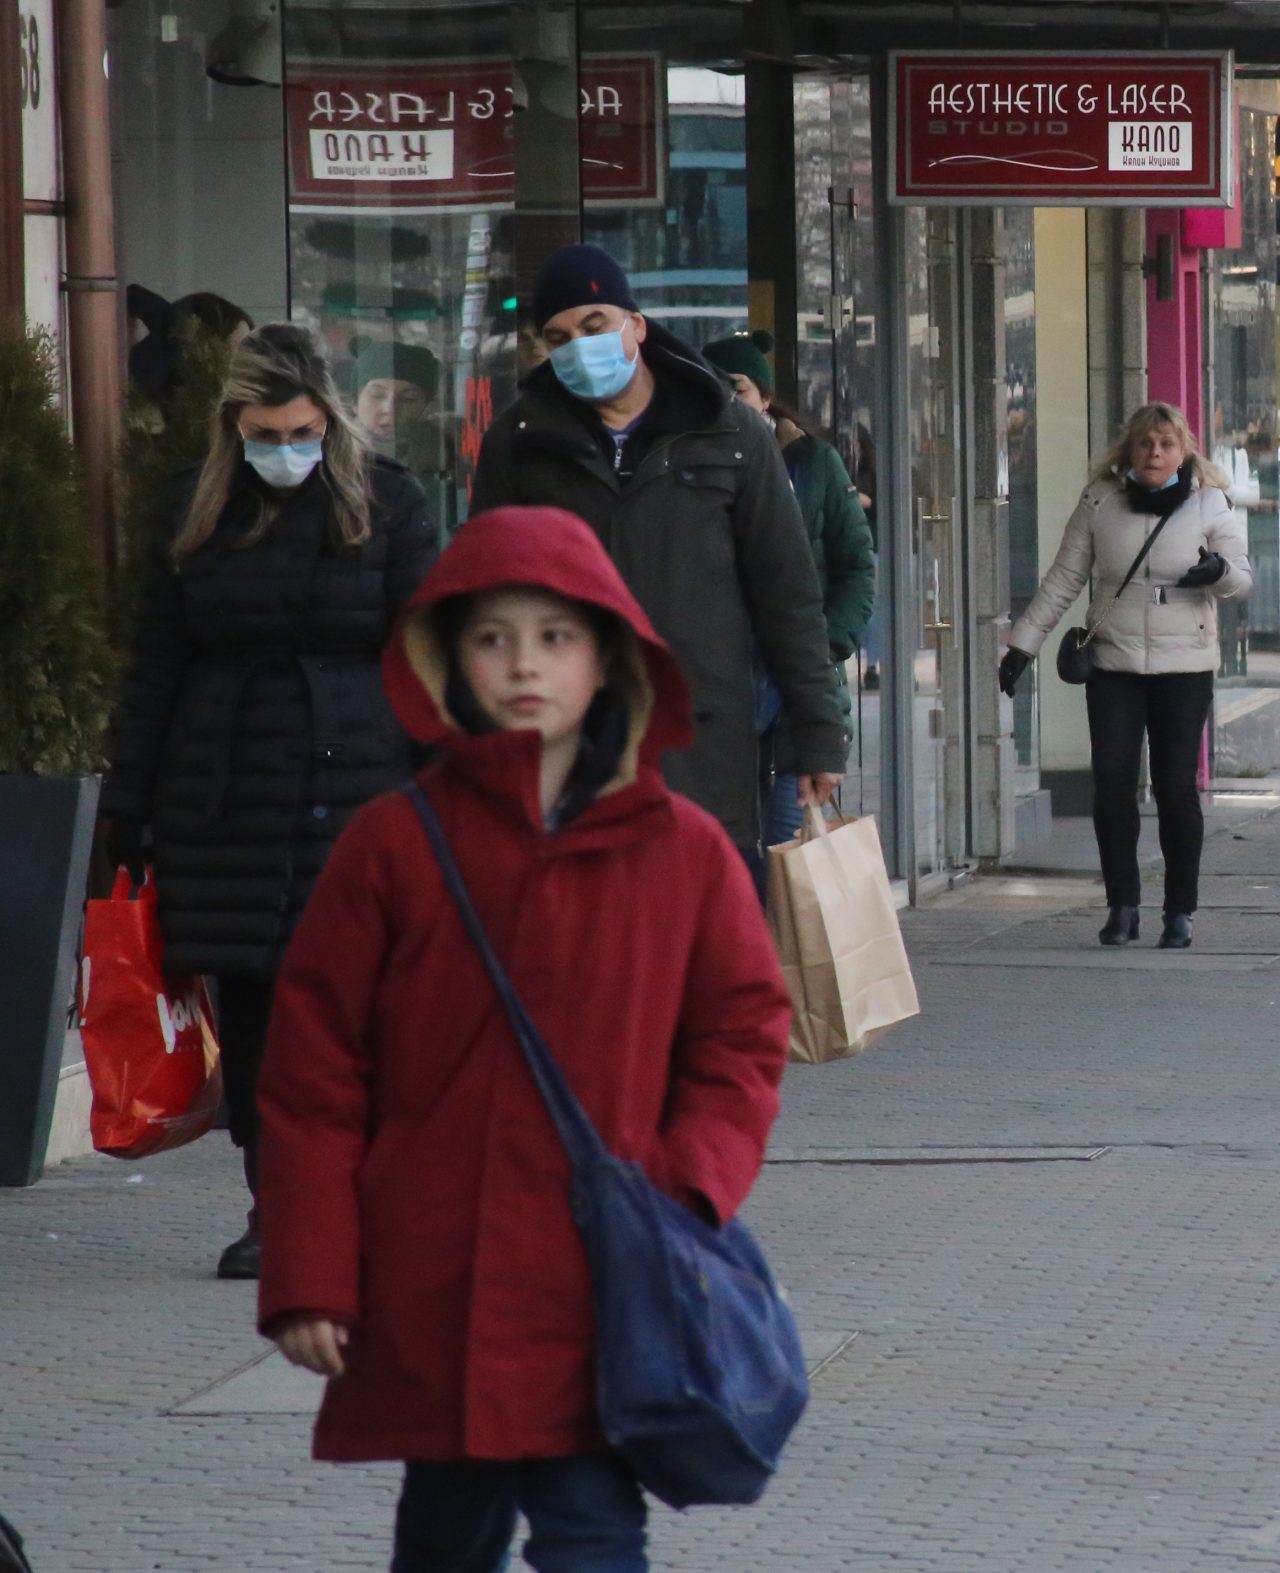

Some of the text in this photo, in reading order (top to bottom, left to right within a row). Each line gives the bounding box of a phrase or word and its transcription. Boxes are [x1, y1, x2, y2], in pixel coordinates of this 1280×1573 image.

[928, 83, 1193, 114] AESTHETIC & LASER
[928, 120, 1069, 136] STUDIO
